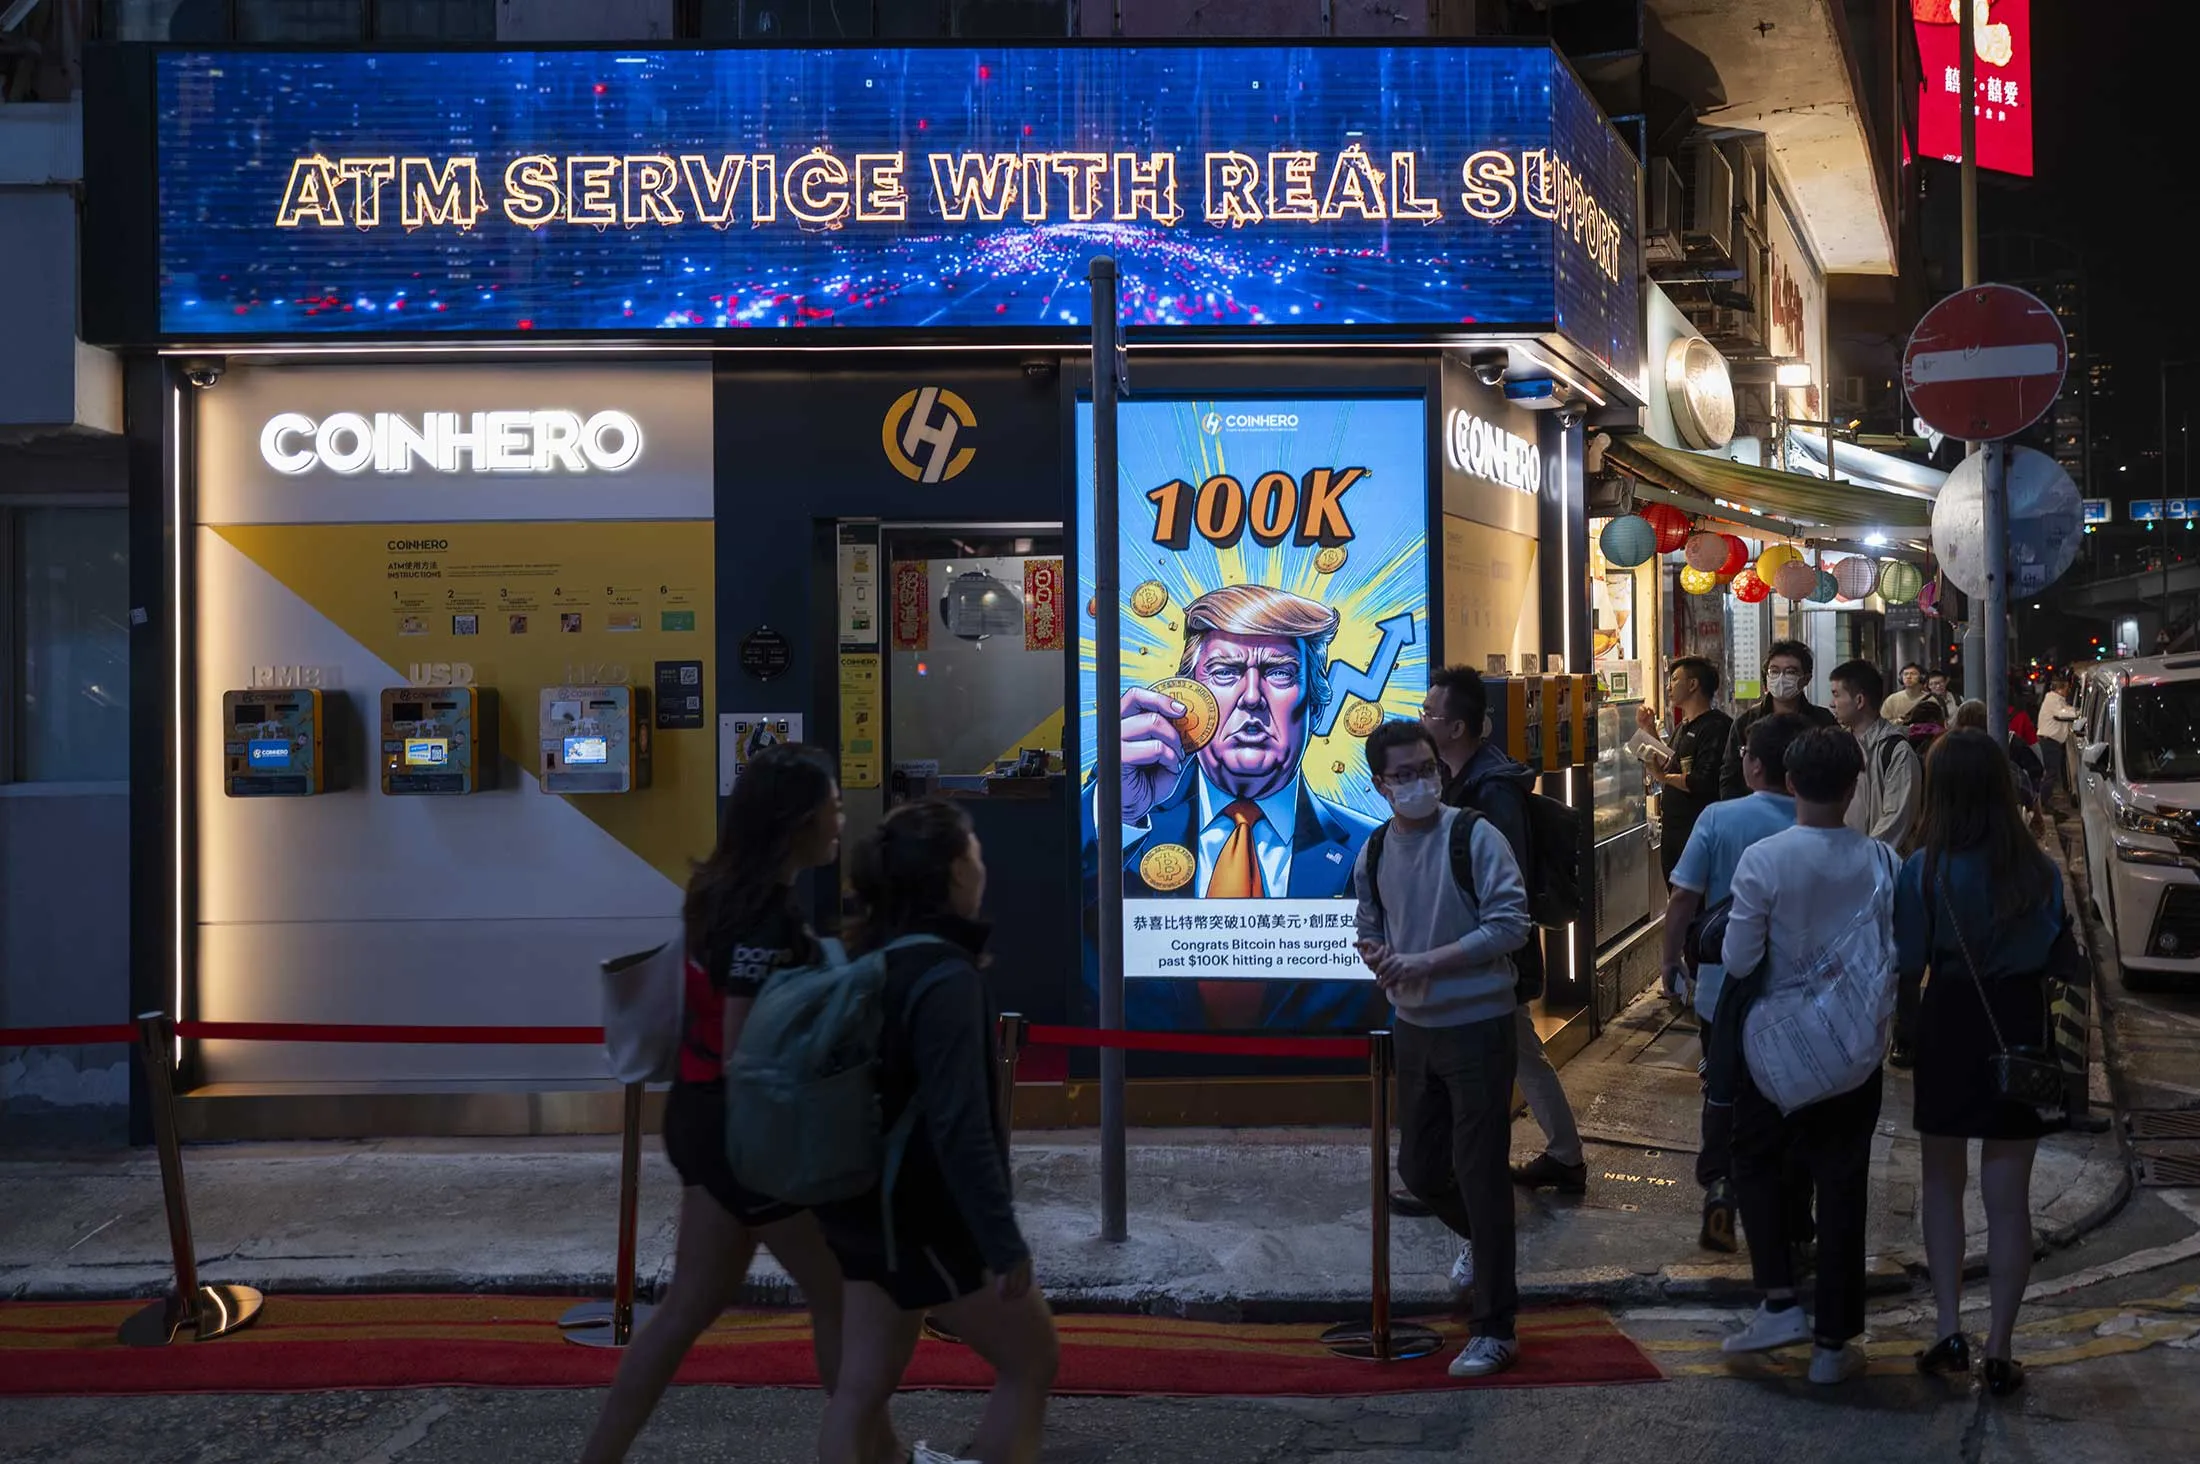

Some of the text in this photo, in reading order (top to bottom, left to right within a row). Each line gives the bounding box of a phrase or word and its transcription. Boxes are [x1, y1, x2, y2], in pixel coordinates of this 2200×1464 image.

[275, 149, 1621, 283] ATM SERVICE WITH REAL SUPPORT
[1225, 415, 1299, 427] COINHERO
[259, 410, 642, 472] COINHERO
[1446, 408, 1541, 495] COINHERO
[1146, 467, 1367, 551] 100K
[387, 540, 448, 550] COINHERO
[387, 571, 441, 579] INSTRUCTIONS
[393, 591, 399, 600] 1
[447, 590, 455, 599] 2
[500, 588, 508, 597] 3
[553, 587, 562, 596] 4
[606, 587, 614, 595] 5
[660, 586, 668, 594] 6
[252, 665, 321, 687] RMB
[409, 662, 474, 686] USD
[1171, 937, 1347, 951] Congrats Bitcoin has surged
[1158, 953, 1360, 968] past $100K hitting a record-high
[1604, 1172, 1676, 1186] NEW T&T
